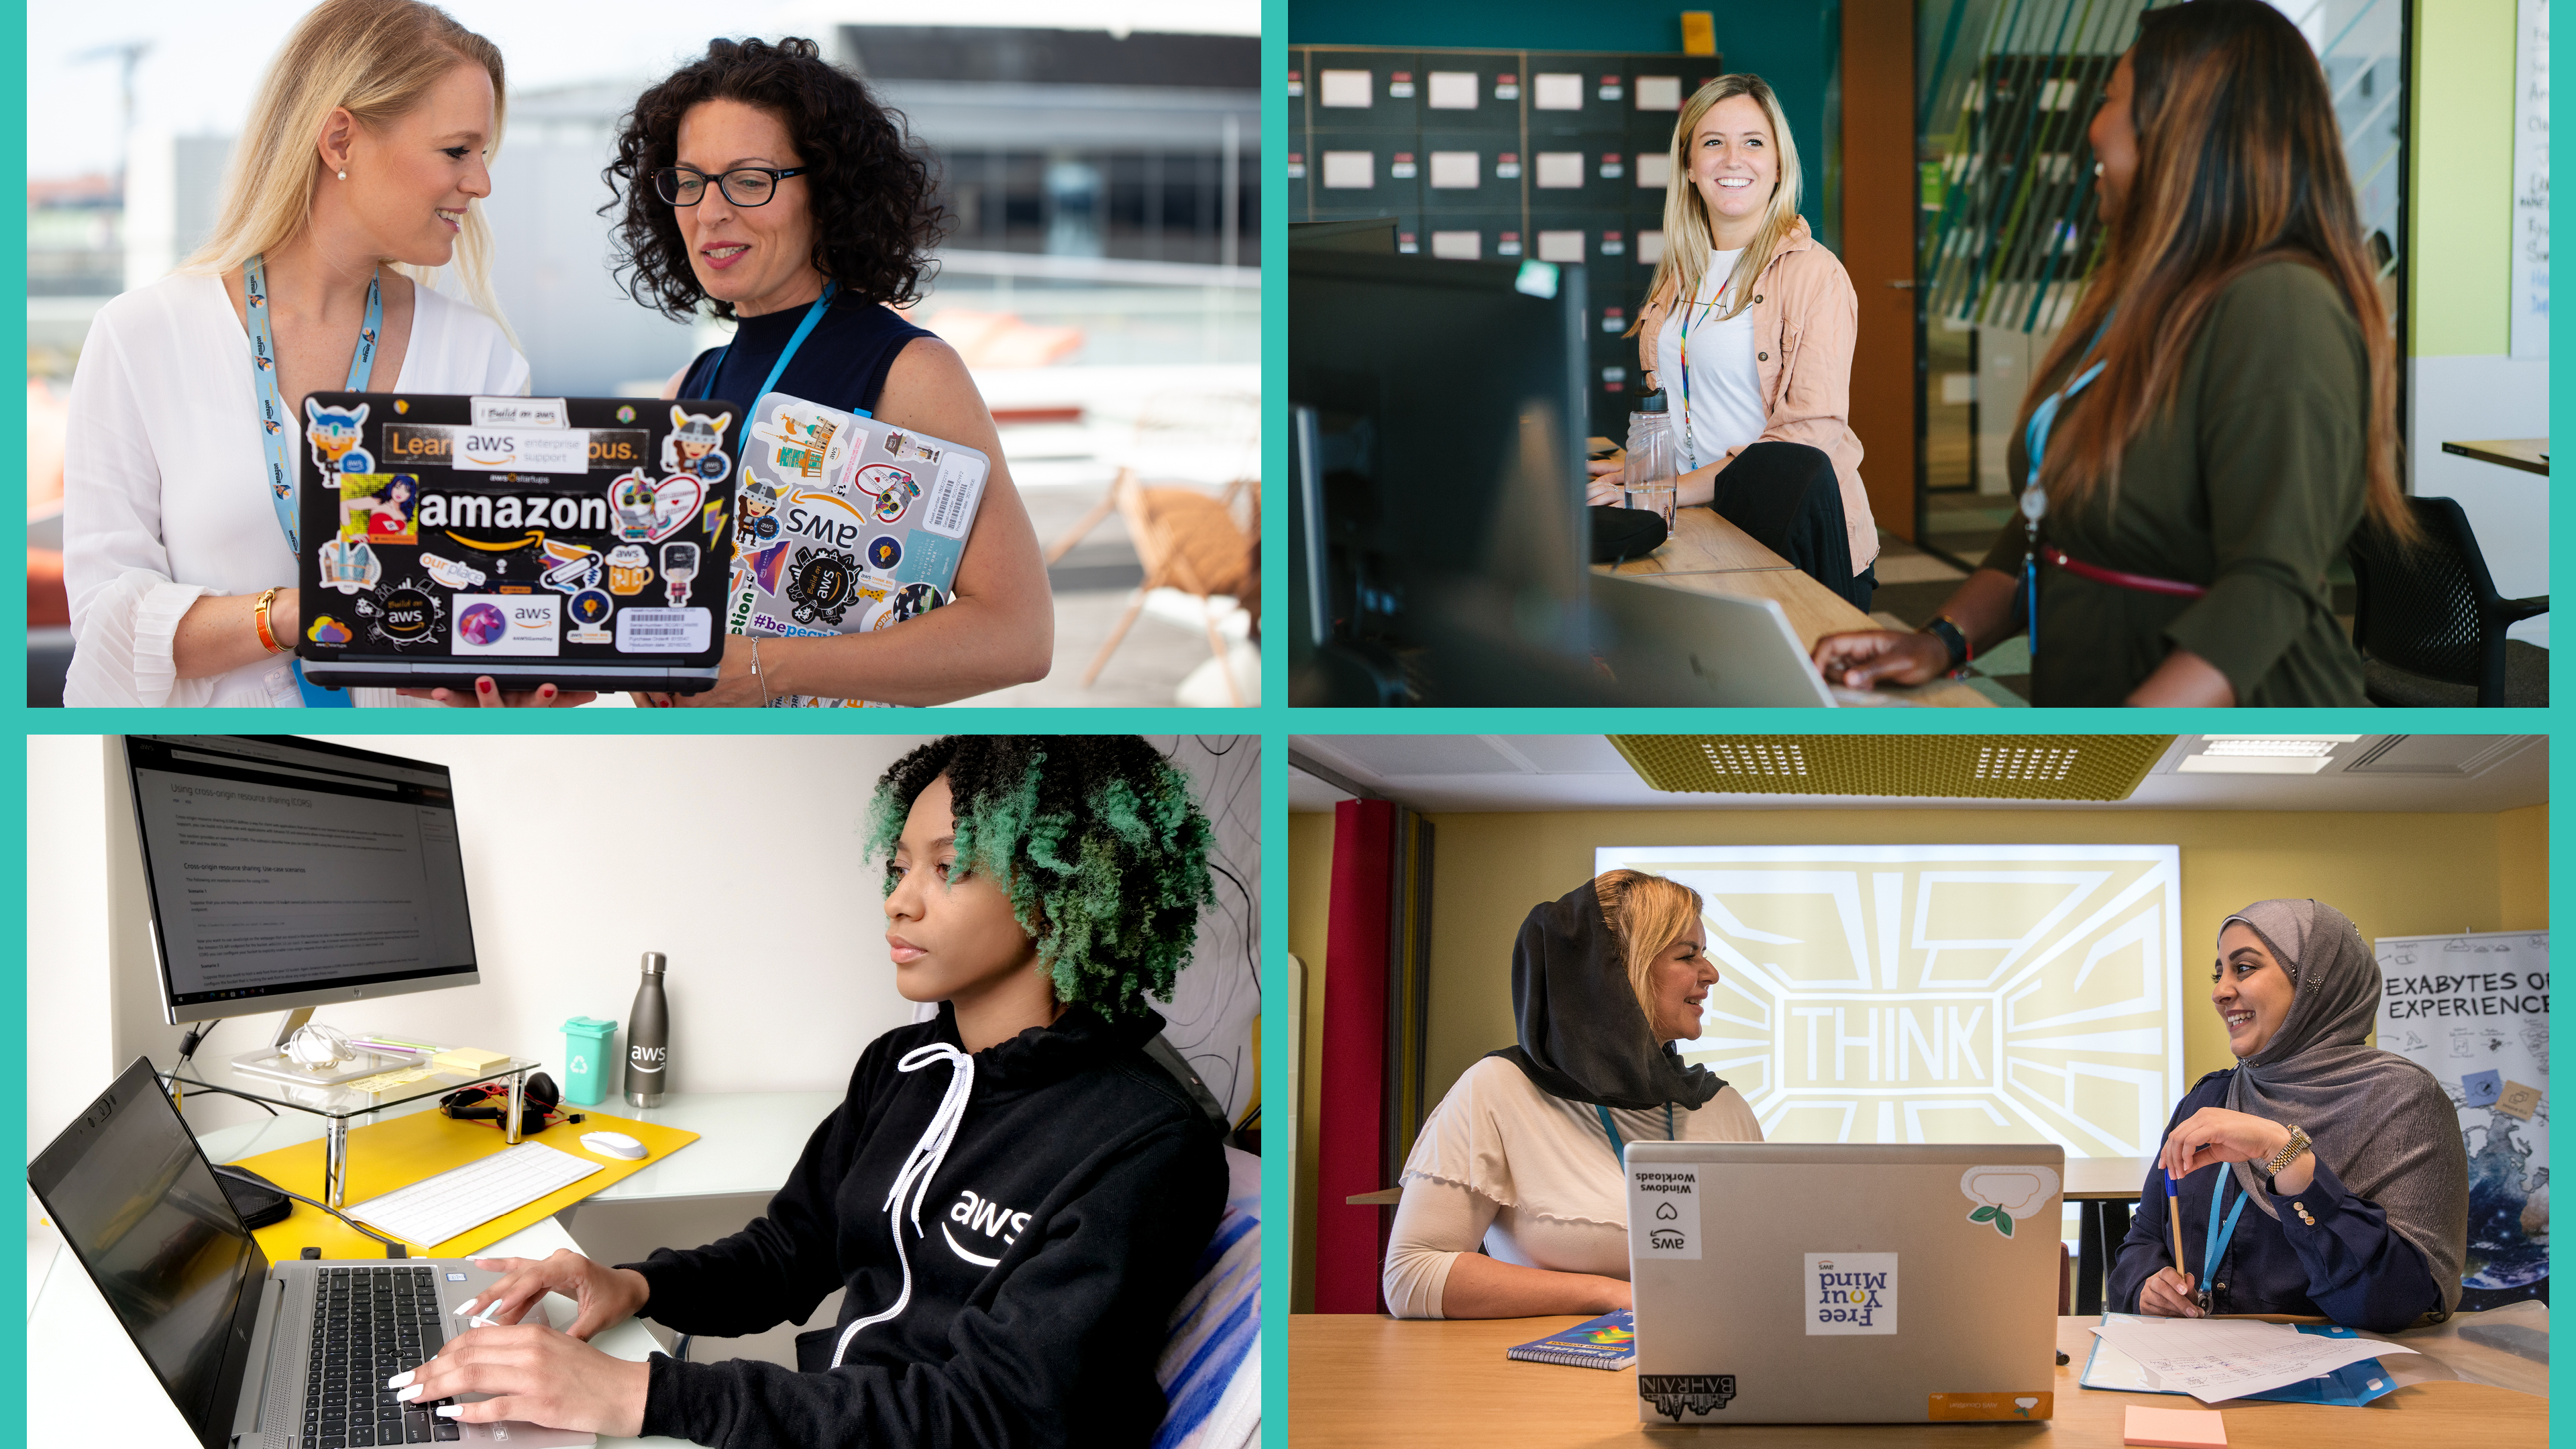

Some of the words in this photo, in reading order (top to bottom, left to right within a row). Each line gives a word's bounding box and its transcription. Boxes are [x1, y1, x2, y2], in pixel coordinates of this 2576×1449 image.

[362, 343, 371, 363] amazon
[354, 360, 362, 377] pioneer
[488, 409, 517, 418] Build
[535, 411, 556, 419] aws
[466, 435, 515, 453] aws
[524, 440, 581, 451] enterprise
[523, 453, 568, 464] support
[829, 446, 838, 460] aws
[273, 463, 281, 484] amazon
[490, 474, 508, 482] aws
[516, 474, 550, 484] startups
[289, 511, 297, 529] pioneer
[419, 494, 607, 530] amazon
[786, 508, 858, 549] aws
[955, 510, 966, 532] Production
[288, 530, 297, 551] amazon
[927, 539, 935, 555] STILL
[616, 549, 639, 558] aws
[917, 538, 930, 572] INNOVATION
[421, 555, 448, 570] our
[447, 561, 483, 583] place
[807, 574, 818, 595] Build
[816, 566, 822, 575] on
[817, 570, 835, 599] aws
[388, 599, 411, 609] Build
[388, 610, 423, 623] aws
[515, 608, 551, 620] aws
[140, 743, 154, 751] aws
[170, 783, 193, 796] Using
[194, 787, 236, 800] cross-origin
[237, 792, 266, 803] resource
[267, 794, 290, 807] sharing
[291, 798, 313, 808] (CORS)
[184, 862, 218, 871] Cross-origin
[241, 865, 262, 873] sharing:
[354, 987, 360, 998] hp
[2385, 972, 2517, 996] EXABYTES
[2527, 973, 2550, 990] O
[1791, 1006, 1985, 1081] THINK
[631, 1044, 666, 1061] aws
[1635, 1171, 1696, 1183] Workloads
[1640, 1183, 1692, 1194] Windows
[951, 1190, 1032, 1246] aws
[1651, 1238, 1685, 1250] aws
[1819, 1273, 1887, 1290] Mind
[1819, 1289, 1883, 1308] Your
[1819, 1308, 1874, 1327] Free
[1641, 1376, 1735, 1394] BAHRAIN
